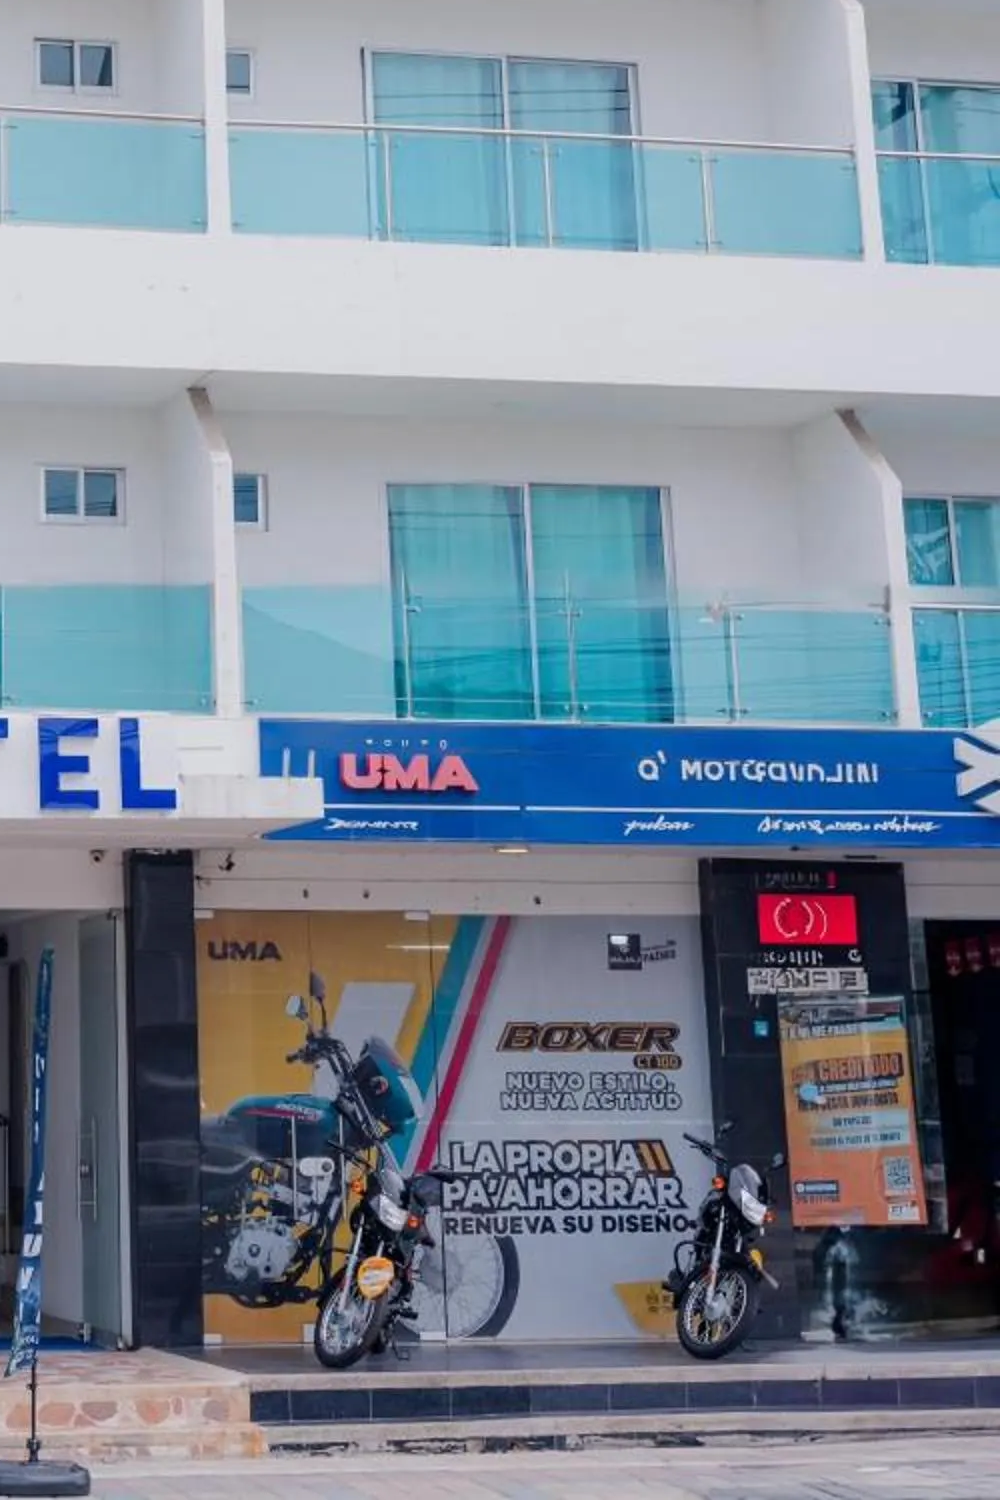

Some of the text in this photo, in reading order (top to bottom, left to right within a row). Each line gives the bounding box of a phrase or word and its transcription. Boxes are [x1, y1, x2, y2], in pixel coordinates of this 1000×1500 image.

[340, 752, 480, 791] UMA
[207, 940, 282, 962] UMA
[496, 1021, 681, 1052] BOXER
[505, 1071, 675, 1092] NUEVO ESTILO,
[500, 1091, 683, 1111] NUEVA ACTITUD
[449, 1140, 642, 1175] LA PROPIA
[497, 1175, 688, 1210] AHORRAR
[444, 1207, 688, 1236] RENUEVA SU DISEÑO
